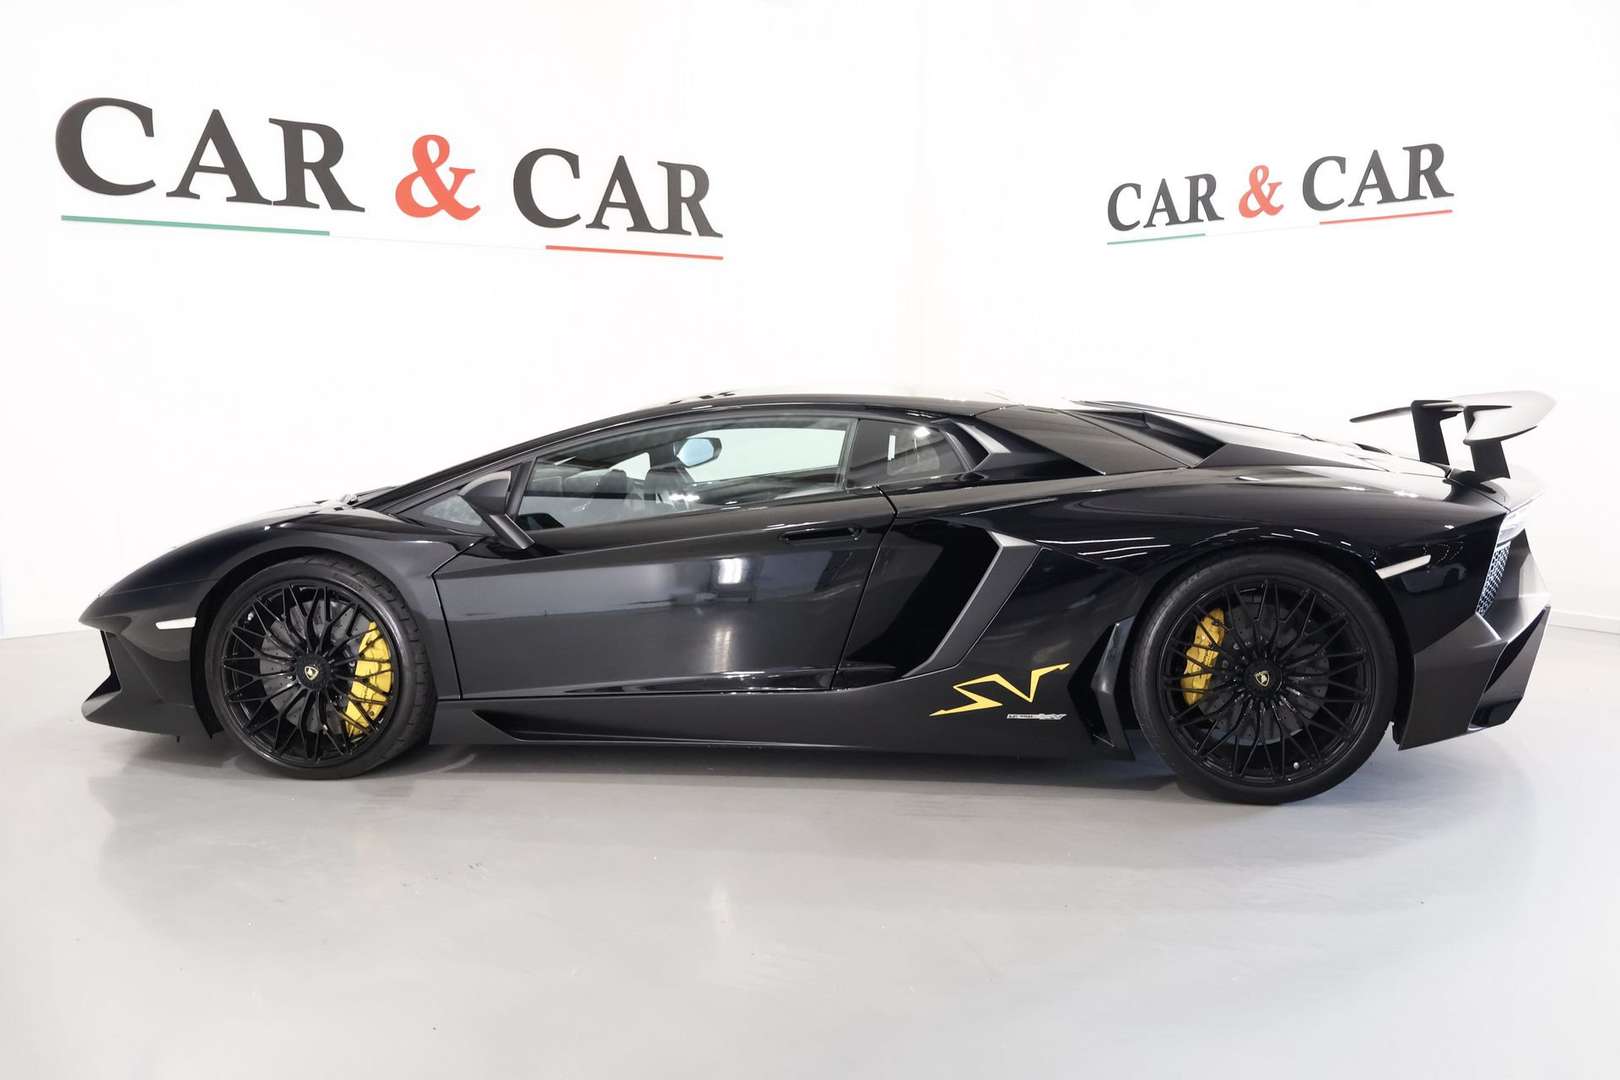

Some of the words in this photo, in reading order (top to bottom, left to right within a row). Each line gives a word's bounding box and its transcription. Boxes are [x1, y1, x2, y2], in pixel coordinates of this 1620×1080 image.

[56, 98, 365, 212] CAR
[395, 134, 480, 220] &
[513, 148, 723, 237] CAR
[1107, 173, 1224, 231] CAR
[1239, 164, 1283, 218] &
[1302, 143, 1454, 211] CAR
